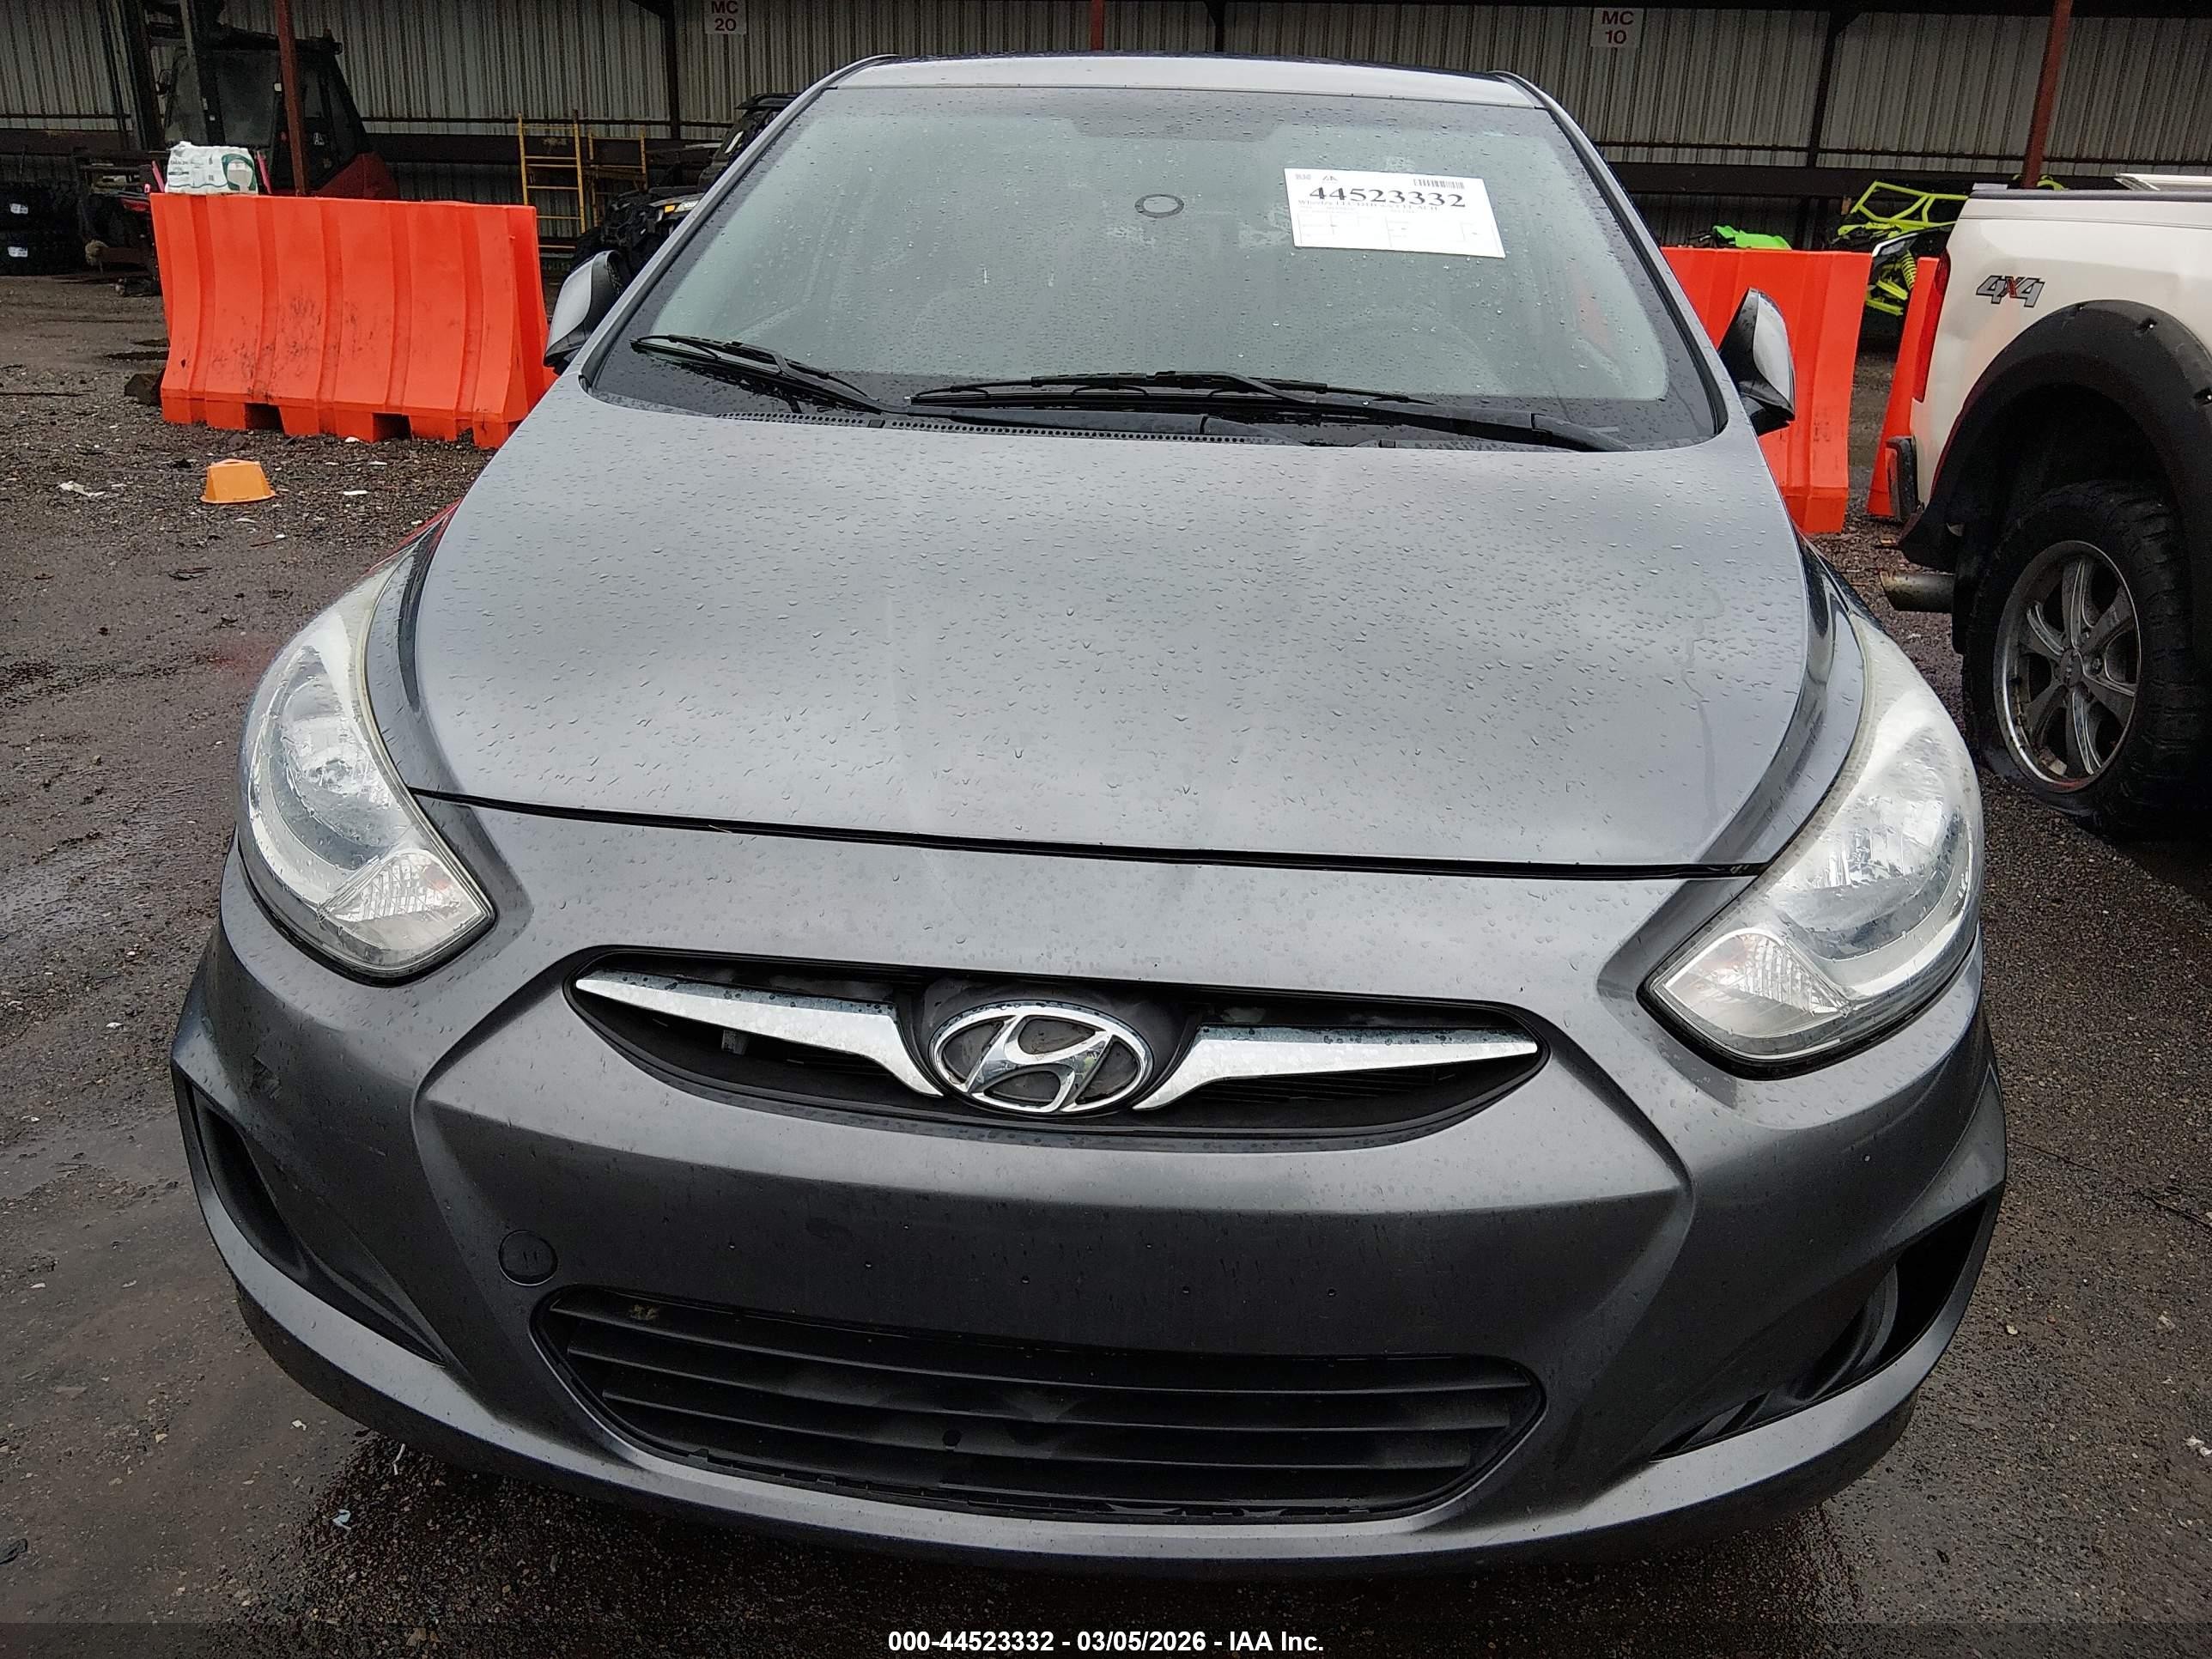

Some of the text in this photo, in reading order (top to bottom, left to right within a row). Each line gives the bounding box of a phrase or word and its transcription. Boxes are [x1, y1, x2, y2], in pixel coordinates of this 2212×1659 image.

[711, 0, 738, 14] MC
[1601, 10, 1634, 25] MC
[714, 18, 737, 32] 20
[1605, 30, 1627, 44] 10
[1310, 186, 1466, 208] 44523332
